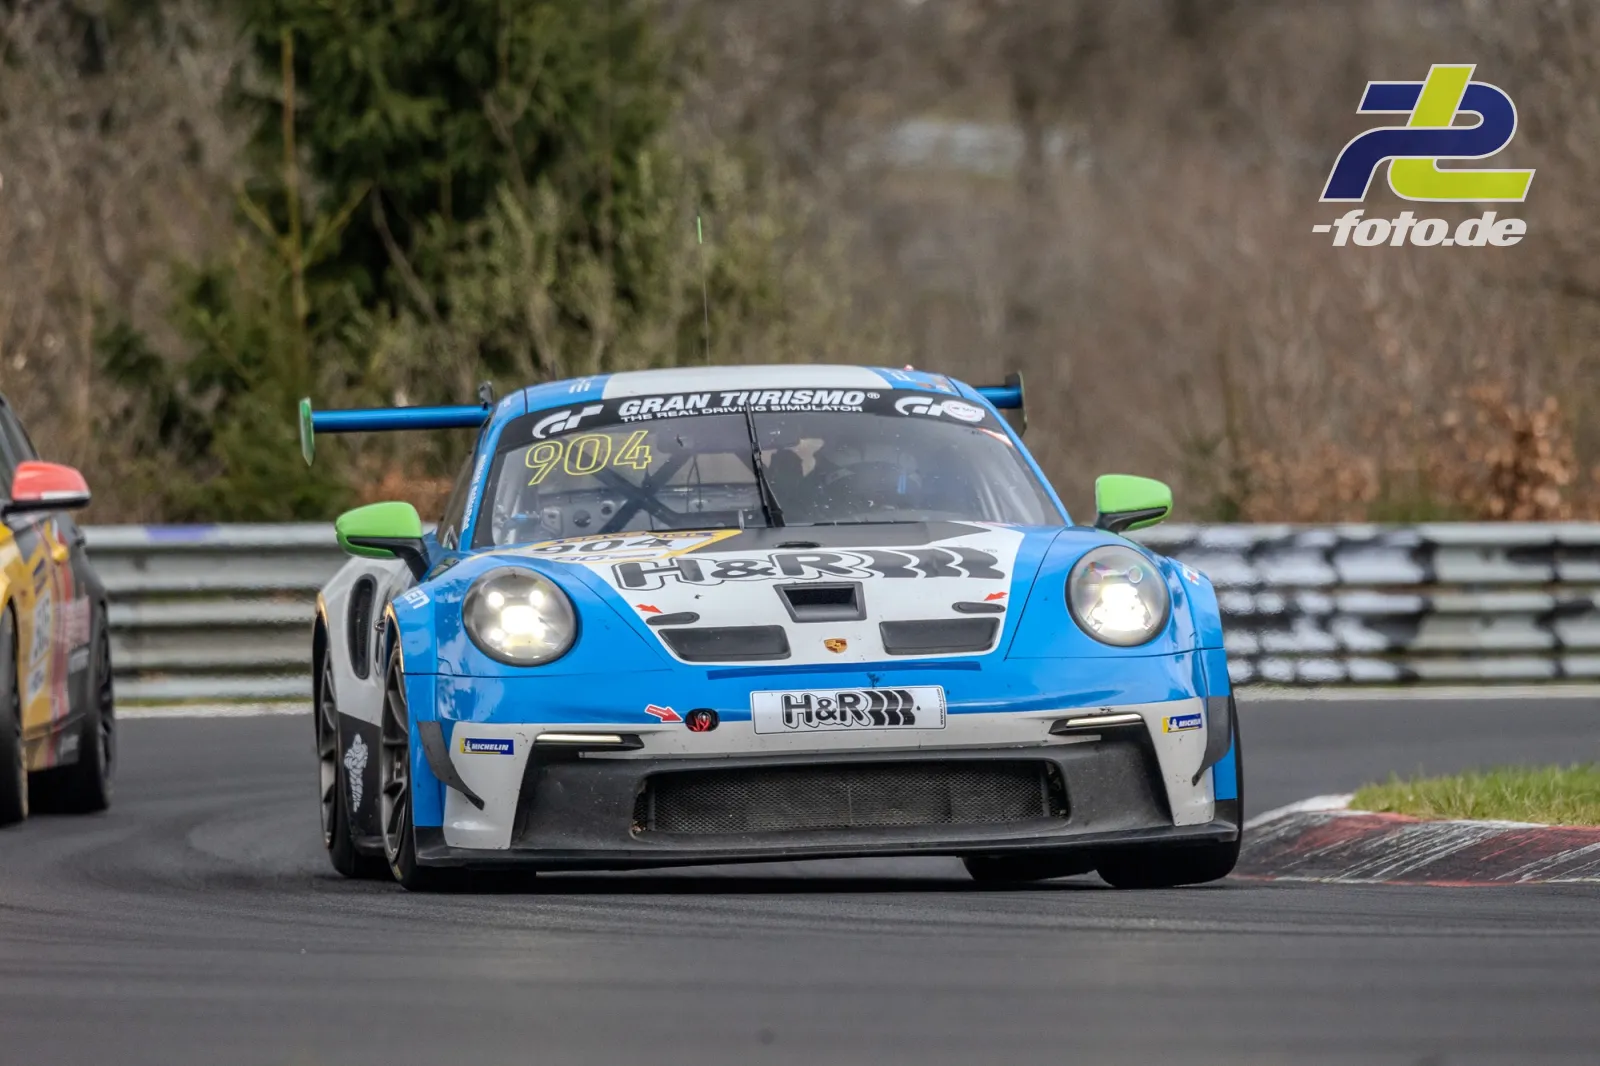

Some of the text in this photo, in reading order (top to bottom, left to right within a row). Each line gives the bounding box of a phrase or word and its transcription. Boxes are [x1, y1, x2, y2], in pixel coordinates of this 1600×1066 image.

[618, 393, 712, 417] GRAN
[620, 404, 863, 423] THE REAL DRIVING SIMULATOR
[525, 429, 653, 487] 904
[532, 537, 673, 555] 904
[471, 743, 509, 751] MICHELIN
